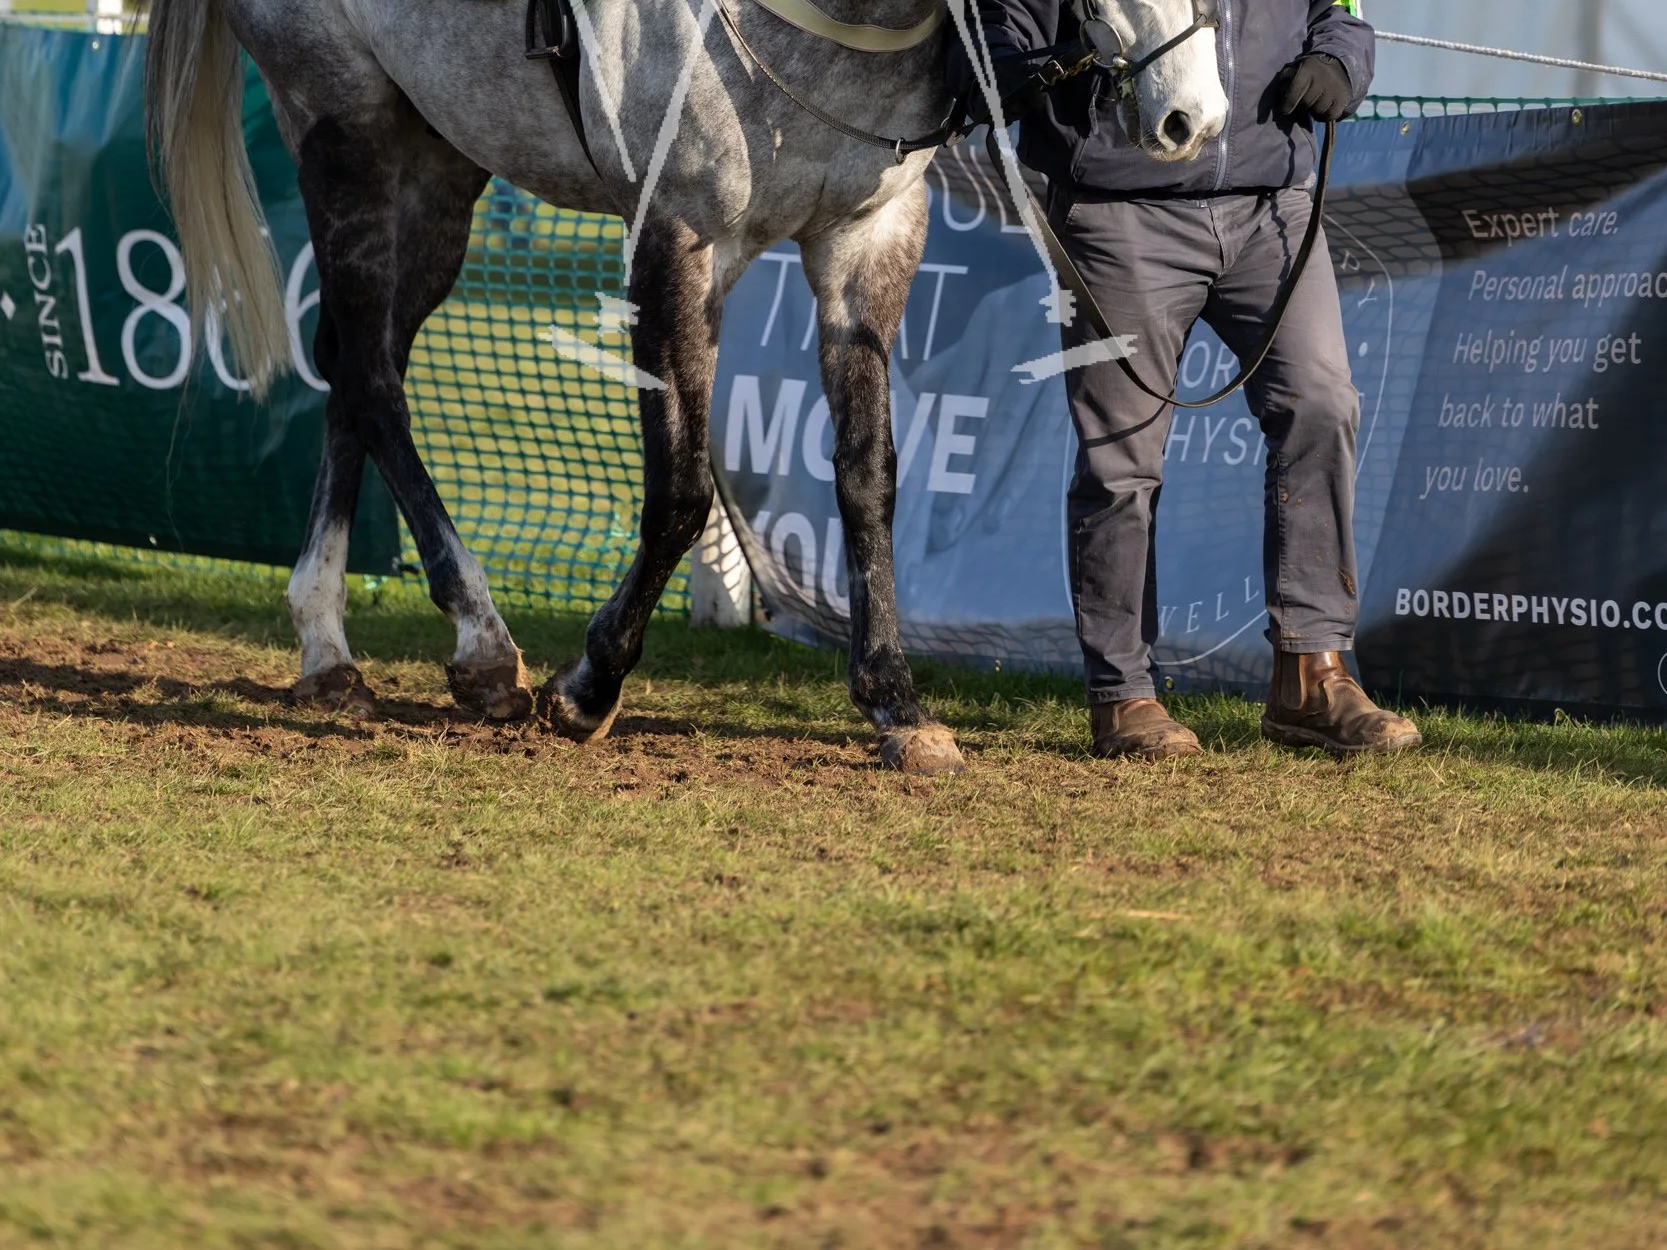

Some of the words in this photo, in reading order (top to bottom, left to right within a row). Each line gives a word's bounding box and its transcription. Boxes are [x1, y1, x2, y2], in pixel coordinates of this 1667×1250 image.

[1462, 207, 1560, 247] Expert
[1568, 210, 1620, 238] care.
[24, 223, 68, 380] SINCE
[1468, 265, 1568, 301] Personal
[758, 250, 969, 362] TT
[1453, 329, 1544, 374] Helping
[1543, 337, 1588, 373] you
[1592, 332, 1642, 373] get
[1438, 393, 1496, 428] back
[1502, 397, 1524, 428] to
[1533, 392, 1600, 430] what
[1419, 466, 1467, 500] you
[1473, 457, 1529, 493] love.
